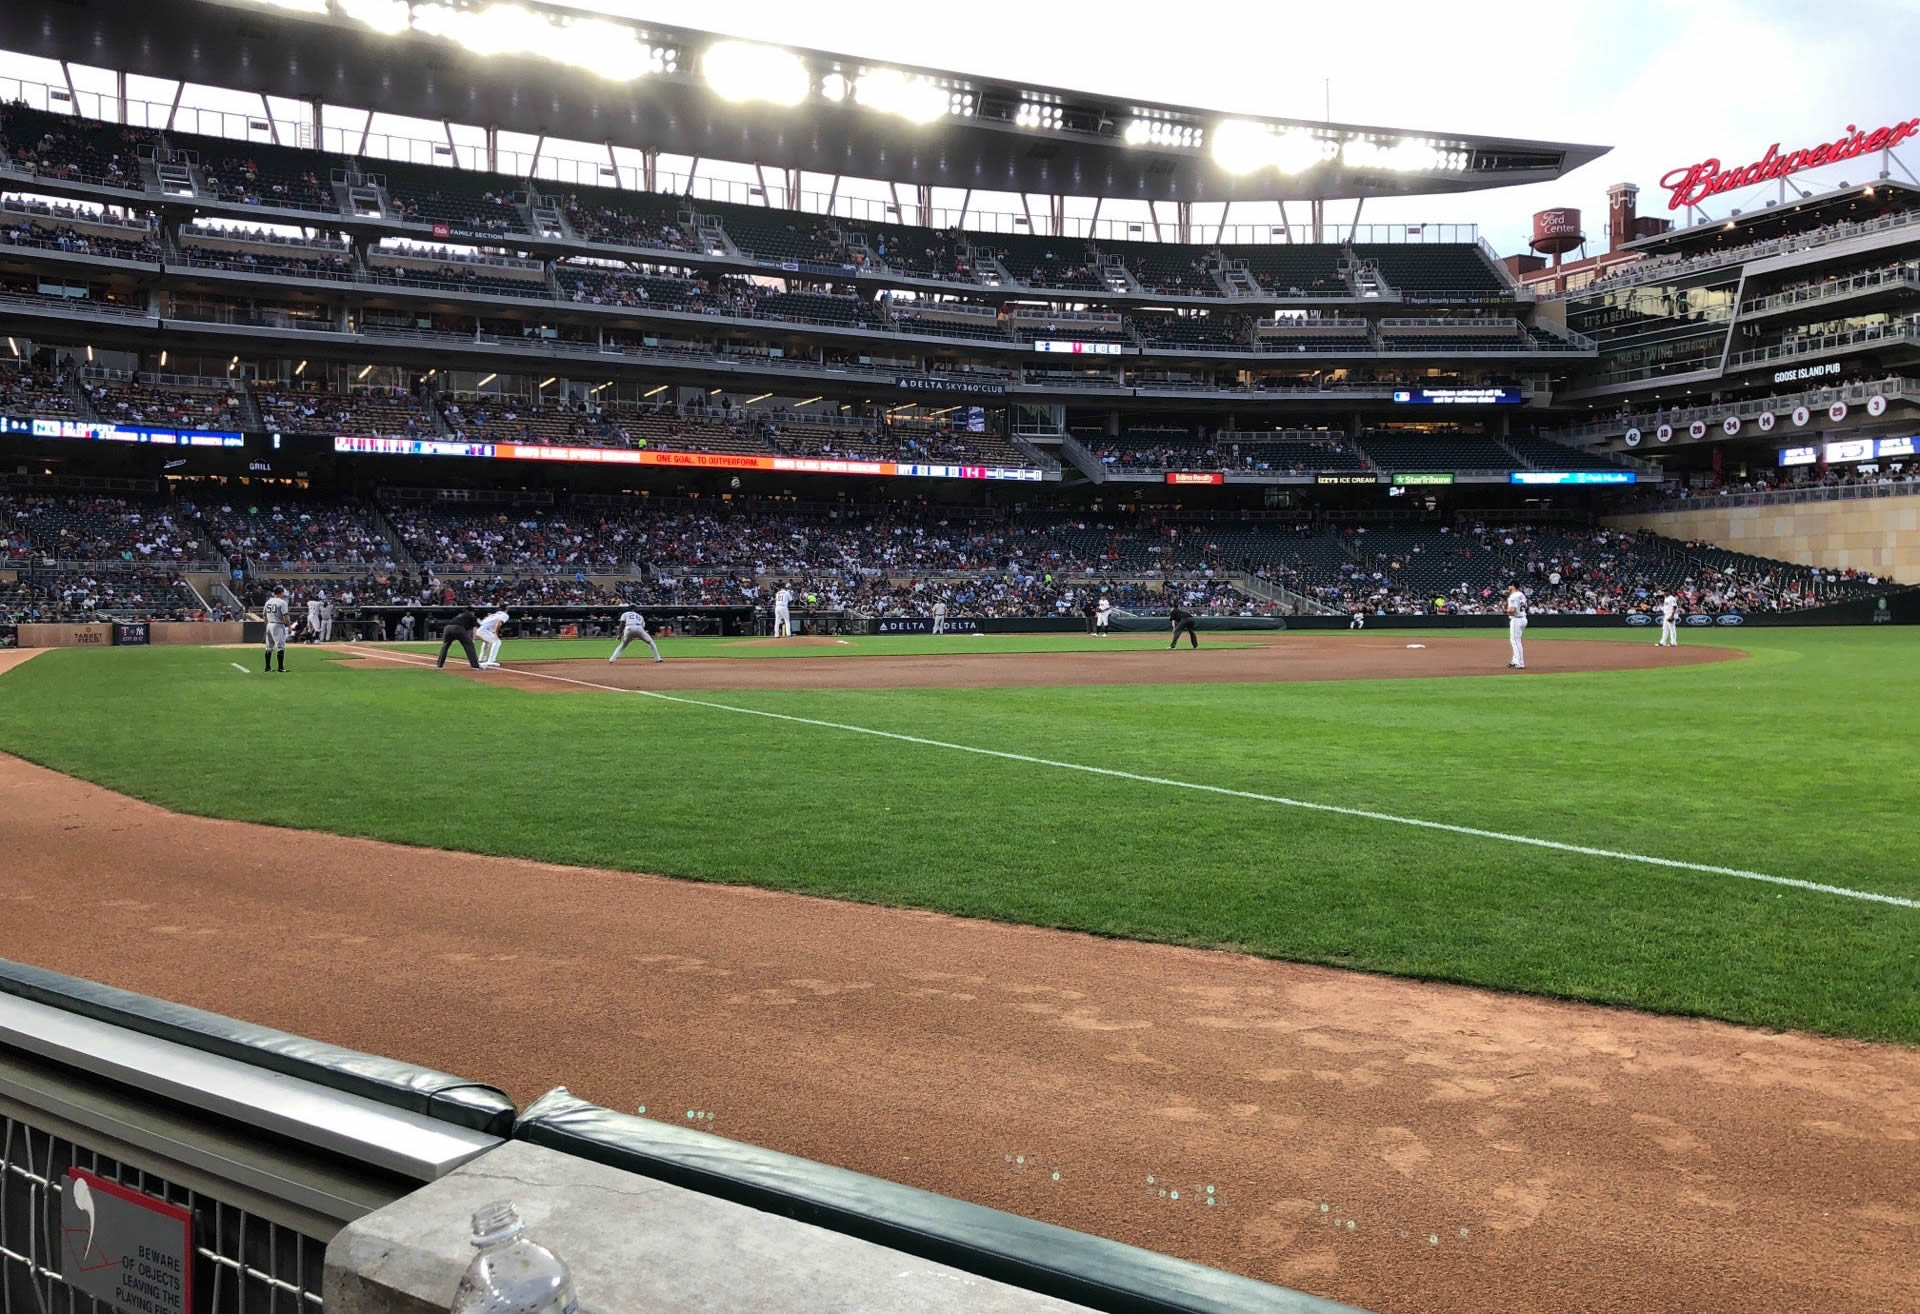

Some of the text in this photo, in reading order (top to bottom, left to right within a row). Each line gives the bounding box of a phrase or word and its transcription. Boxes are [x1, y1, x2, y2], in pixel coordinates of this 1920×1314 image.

[1660, 117, 1920, 210] Budweiser
[1540, 211, 1564, 226] Ford
[1544, 224, 1575, 234] Center
[474, 232, 504, 240] SECTION
[1584, 315, 1600, 328] IT'S
[1602, 313, 1609, 324] A
[1617, 351, 1632, 362] THIS
[1634, 352, 1640, 360] IS
[1774, 362, 1840, 383] GOOSE ISLAND PUB
[910, 380, 942, 390] DELTA
[982, 385, 1002, 393] CLUB
[1832, 406, 1844, 416] 29
[1762, 416, 1770, 426] 14
[1726, 422, 1737, 431] 34
[1628, 433, 1638, 442] 42
[1660, 428, 1668, 438] 10
[656, 454, 758, 466] ONE GOAL. TO OUTPERFORM.
[249, 462, 272, 471] GRILL
[1405, 476, 1451, 484] StarTribune
[266, 604, 277, 614] 50
[890, 622, 925, 630] DELTA
[944, 622, 976, 630] DELTA
[138, 1245, 180, 1272] BEWARE
[122, 1256, 180, 1290] OF OBJECTS
[122, 1273, 180, 1308] LEAVING THE
[116, 1287, 152, 1313] PLAYING
